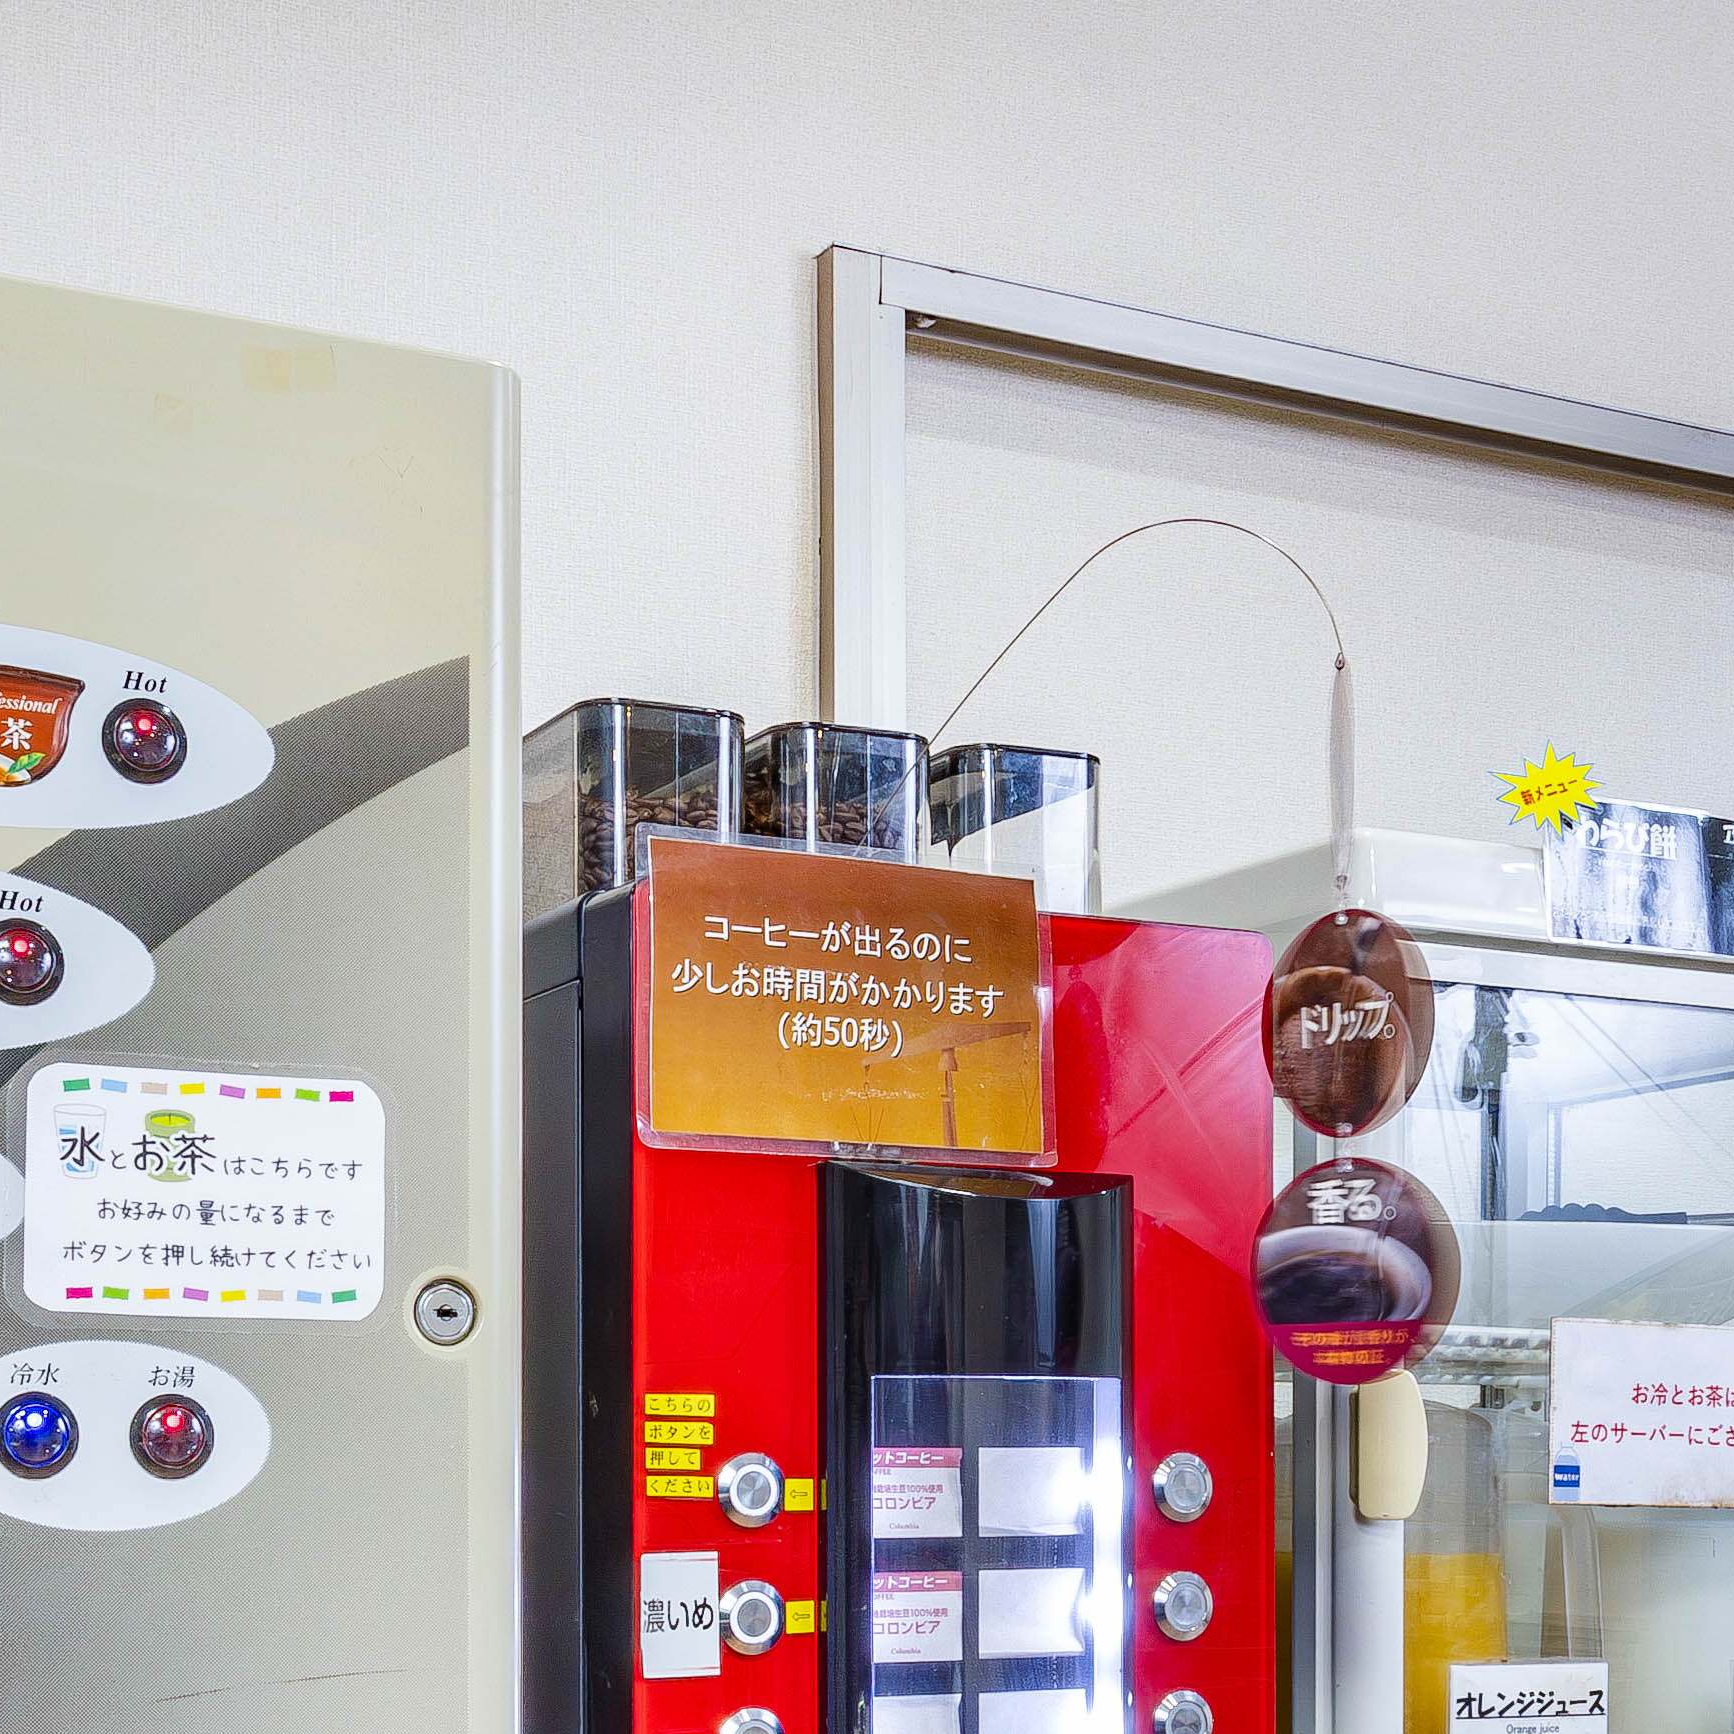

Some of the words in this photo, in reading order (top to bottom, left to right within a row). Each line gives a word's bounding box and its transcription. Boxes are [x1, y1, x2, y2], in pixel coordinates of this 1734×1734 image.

[122, 669, 168, 695] Hot
[1520, 778, 1579, 806] 新メニュー
[703, 914, 974, 964] コーヒーが出るのに
[670, 957, 1005, 1018] 少しお時間がかかります
[777, 1010, 905, 1059] (約50秒)
[58, 1124, 364, 1183] 水とお茶はこちらです
[97, 1198, 336, 1229] お好みの量になるまで
[62, 1240, 372, 1272] ボタンを押し続けてください
[10, 1362, 61, 1387] 冷水
[148, 1366, 197, 1388] お湯
[648, 1397, 711, 1413] こちらの
[649, 1424, 712, 1441] ボタンを
[650, 1449, 698, 1467] 押して
[649, 1478, 711, 1495] ください
[873, 1496, 937, 1510] コロンビア
[642, 1596, 714, 1635] 濃いめ
[873, 1620, 941, 1635] コロンビア
[1456, 1689, 1606, 1719] オレンジジュース
[1505, 1723, 1537, 1734] Orange
[1538, 1722, 1560, 1734] juice
